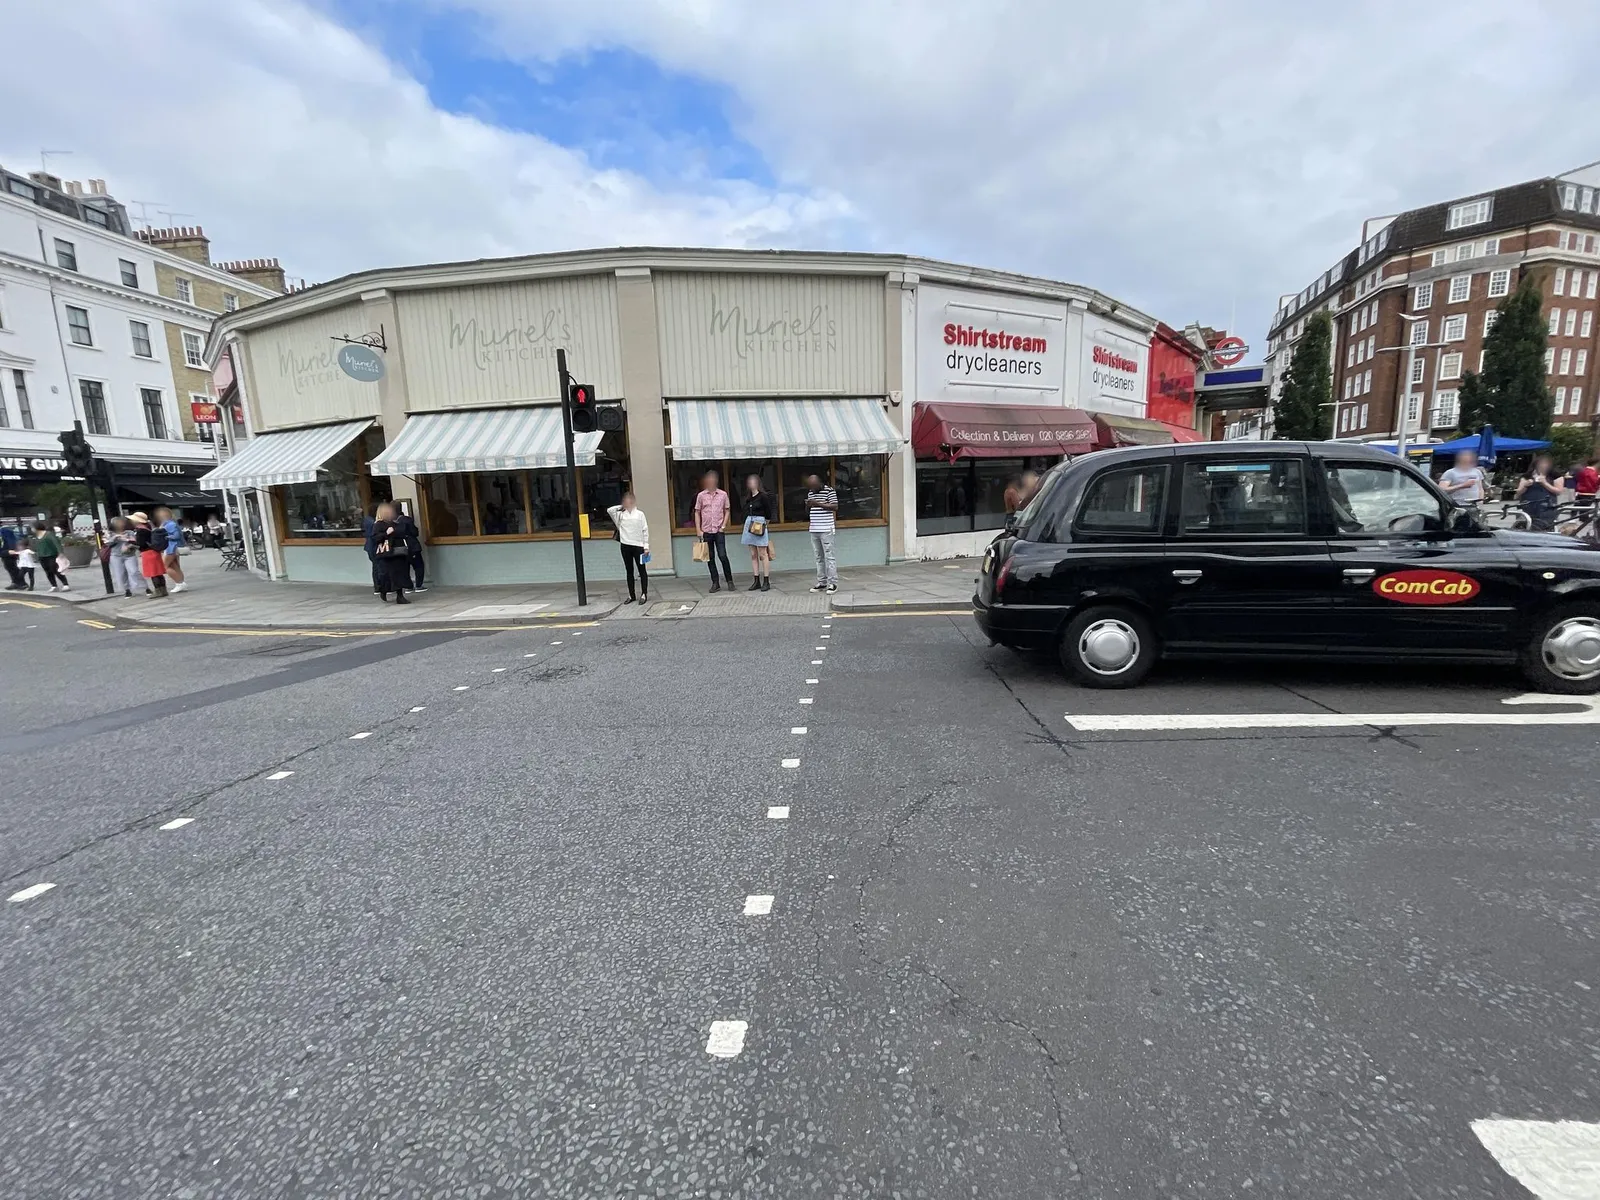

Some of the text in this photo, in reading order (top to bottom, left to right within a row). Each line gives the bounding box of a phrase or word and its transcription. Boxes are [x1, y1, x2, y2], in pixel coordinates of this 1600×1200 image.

[709, 293, 837, 360] Muriel's
[449, 308, 572, 371] Muriel's
[744, 339, 837, 352] KITCHEN
[943, 323, 1047, 353] Shirtstream
[480, 344, 573, 363] KITCHEN
[1093, 345, 1138, 373] Shirtstream
[1212, 346, 1248, 355] UNDERGROUND
[277, 340, 338, 396] Muriel
[946, 350, 1042, 375] drycleaners
[298, 369, 340, 389] KITCHE
[1092, 367, 1135, 391] drycleaners
[993, 431, 1000, 440] &
[1002, 430, 1035, 443] Delivery
[1039, 430, 1053, 441] 020
[0, 457, 68, 471] VE GUY
[150, 464, 185, 474] PAUL
[1380, 577, 1472, 595] ComCab
